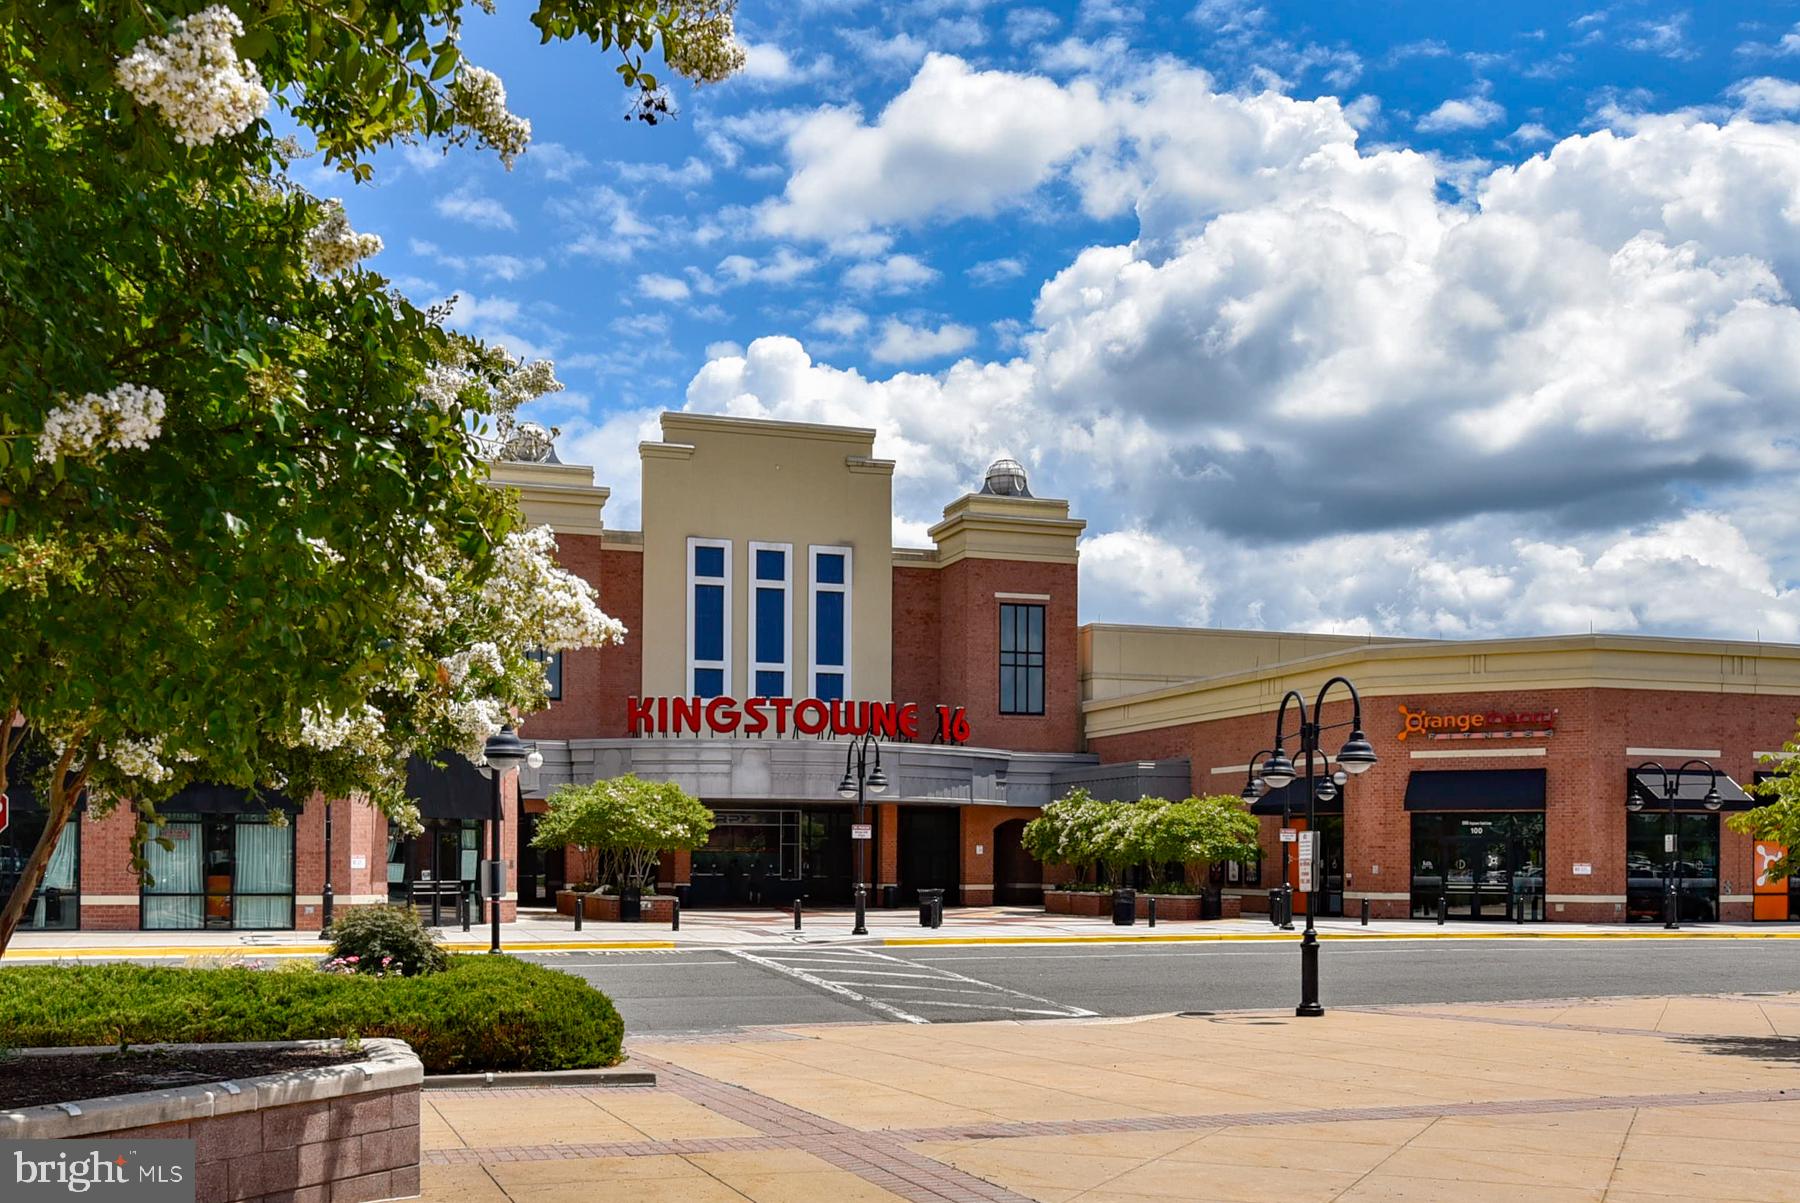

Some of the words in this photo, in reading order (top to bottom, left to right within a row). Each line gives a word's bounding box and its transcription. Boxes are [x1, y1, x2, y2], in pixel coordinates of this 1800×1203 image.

[627, 695, 918, 738] KINGSTOWNE
[936, 704, 970, 742] 16
[1470, 827, 1483, 835] 100
